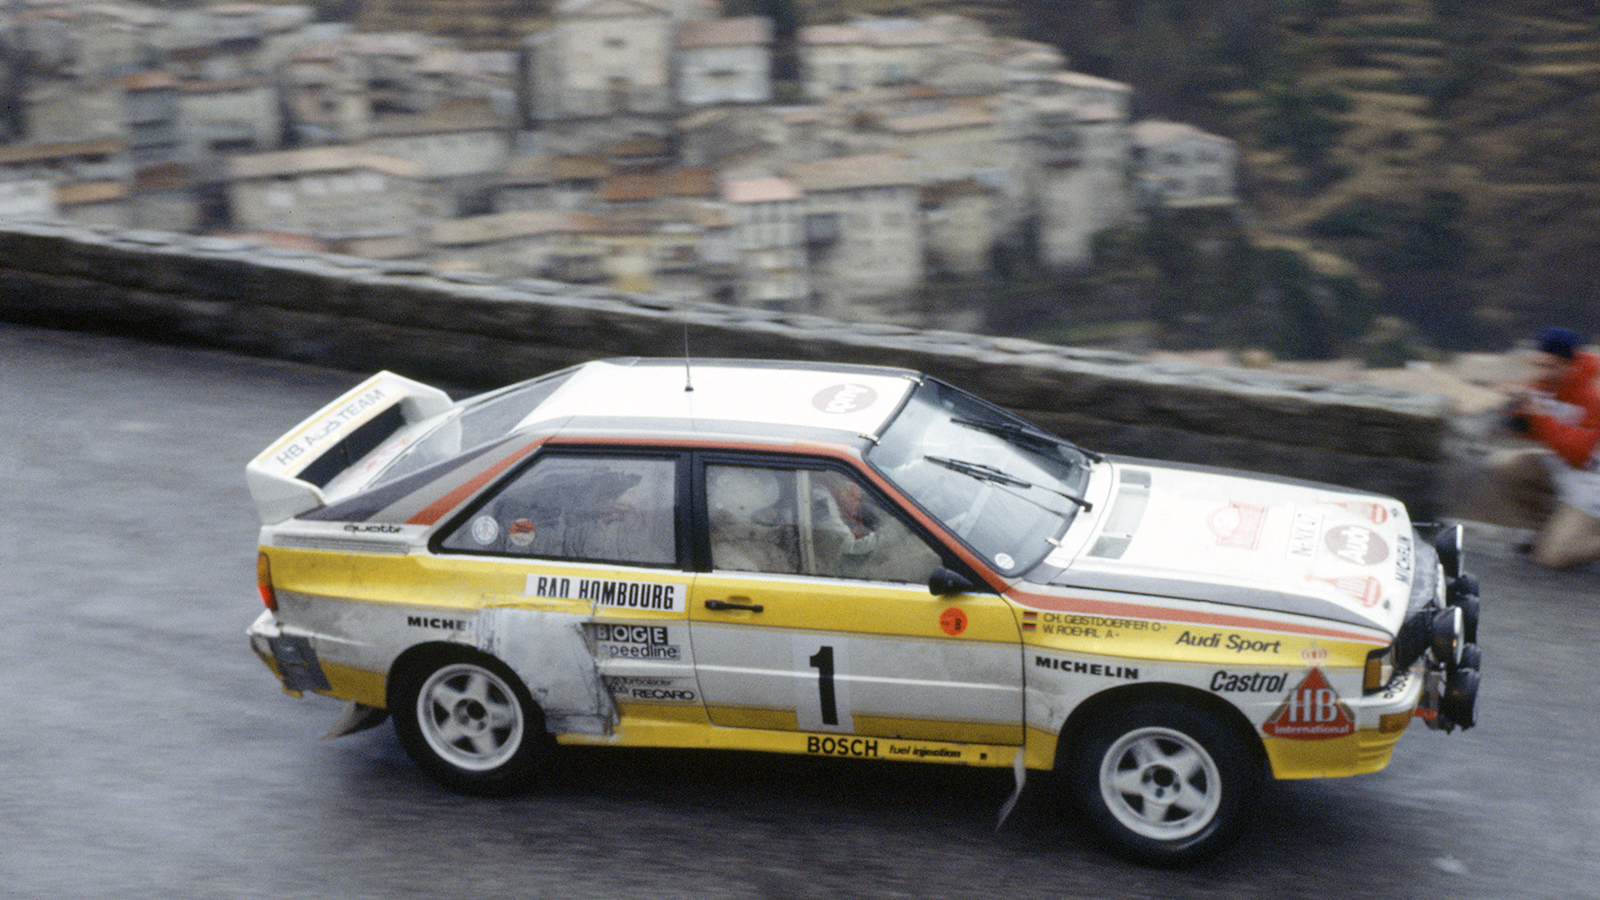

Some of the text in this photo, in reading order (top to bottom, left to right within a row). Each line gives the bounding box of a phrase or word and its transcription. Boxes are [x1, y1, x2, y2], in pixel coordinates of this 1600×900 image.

[276, 444, 305, 466] HB
[337, 389, 385, 420] TEAM
[1337, 525, 1371, 566] Audi
[1395, 534, 1411, 587] MICHELIN
[578, 579, 675, 611] HOMBOURG
[1175, 630, 1281, 654] Audi Sport
[1035, 655, 1139, 680] MICHELIN
[1209, 670, 1289, 693] Castrol
[632, 688, 696, 701] RECARO
[809, 645, 838, 725] 1
[1288, 688, 1338, 723] HB
[807, 736, 878, 757] BOSCH
[889, 745, 911, 755] fuel
